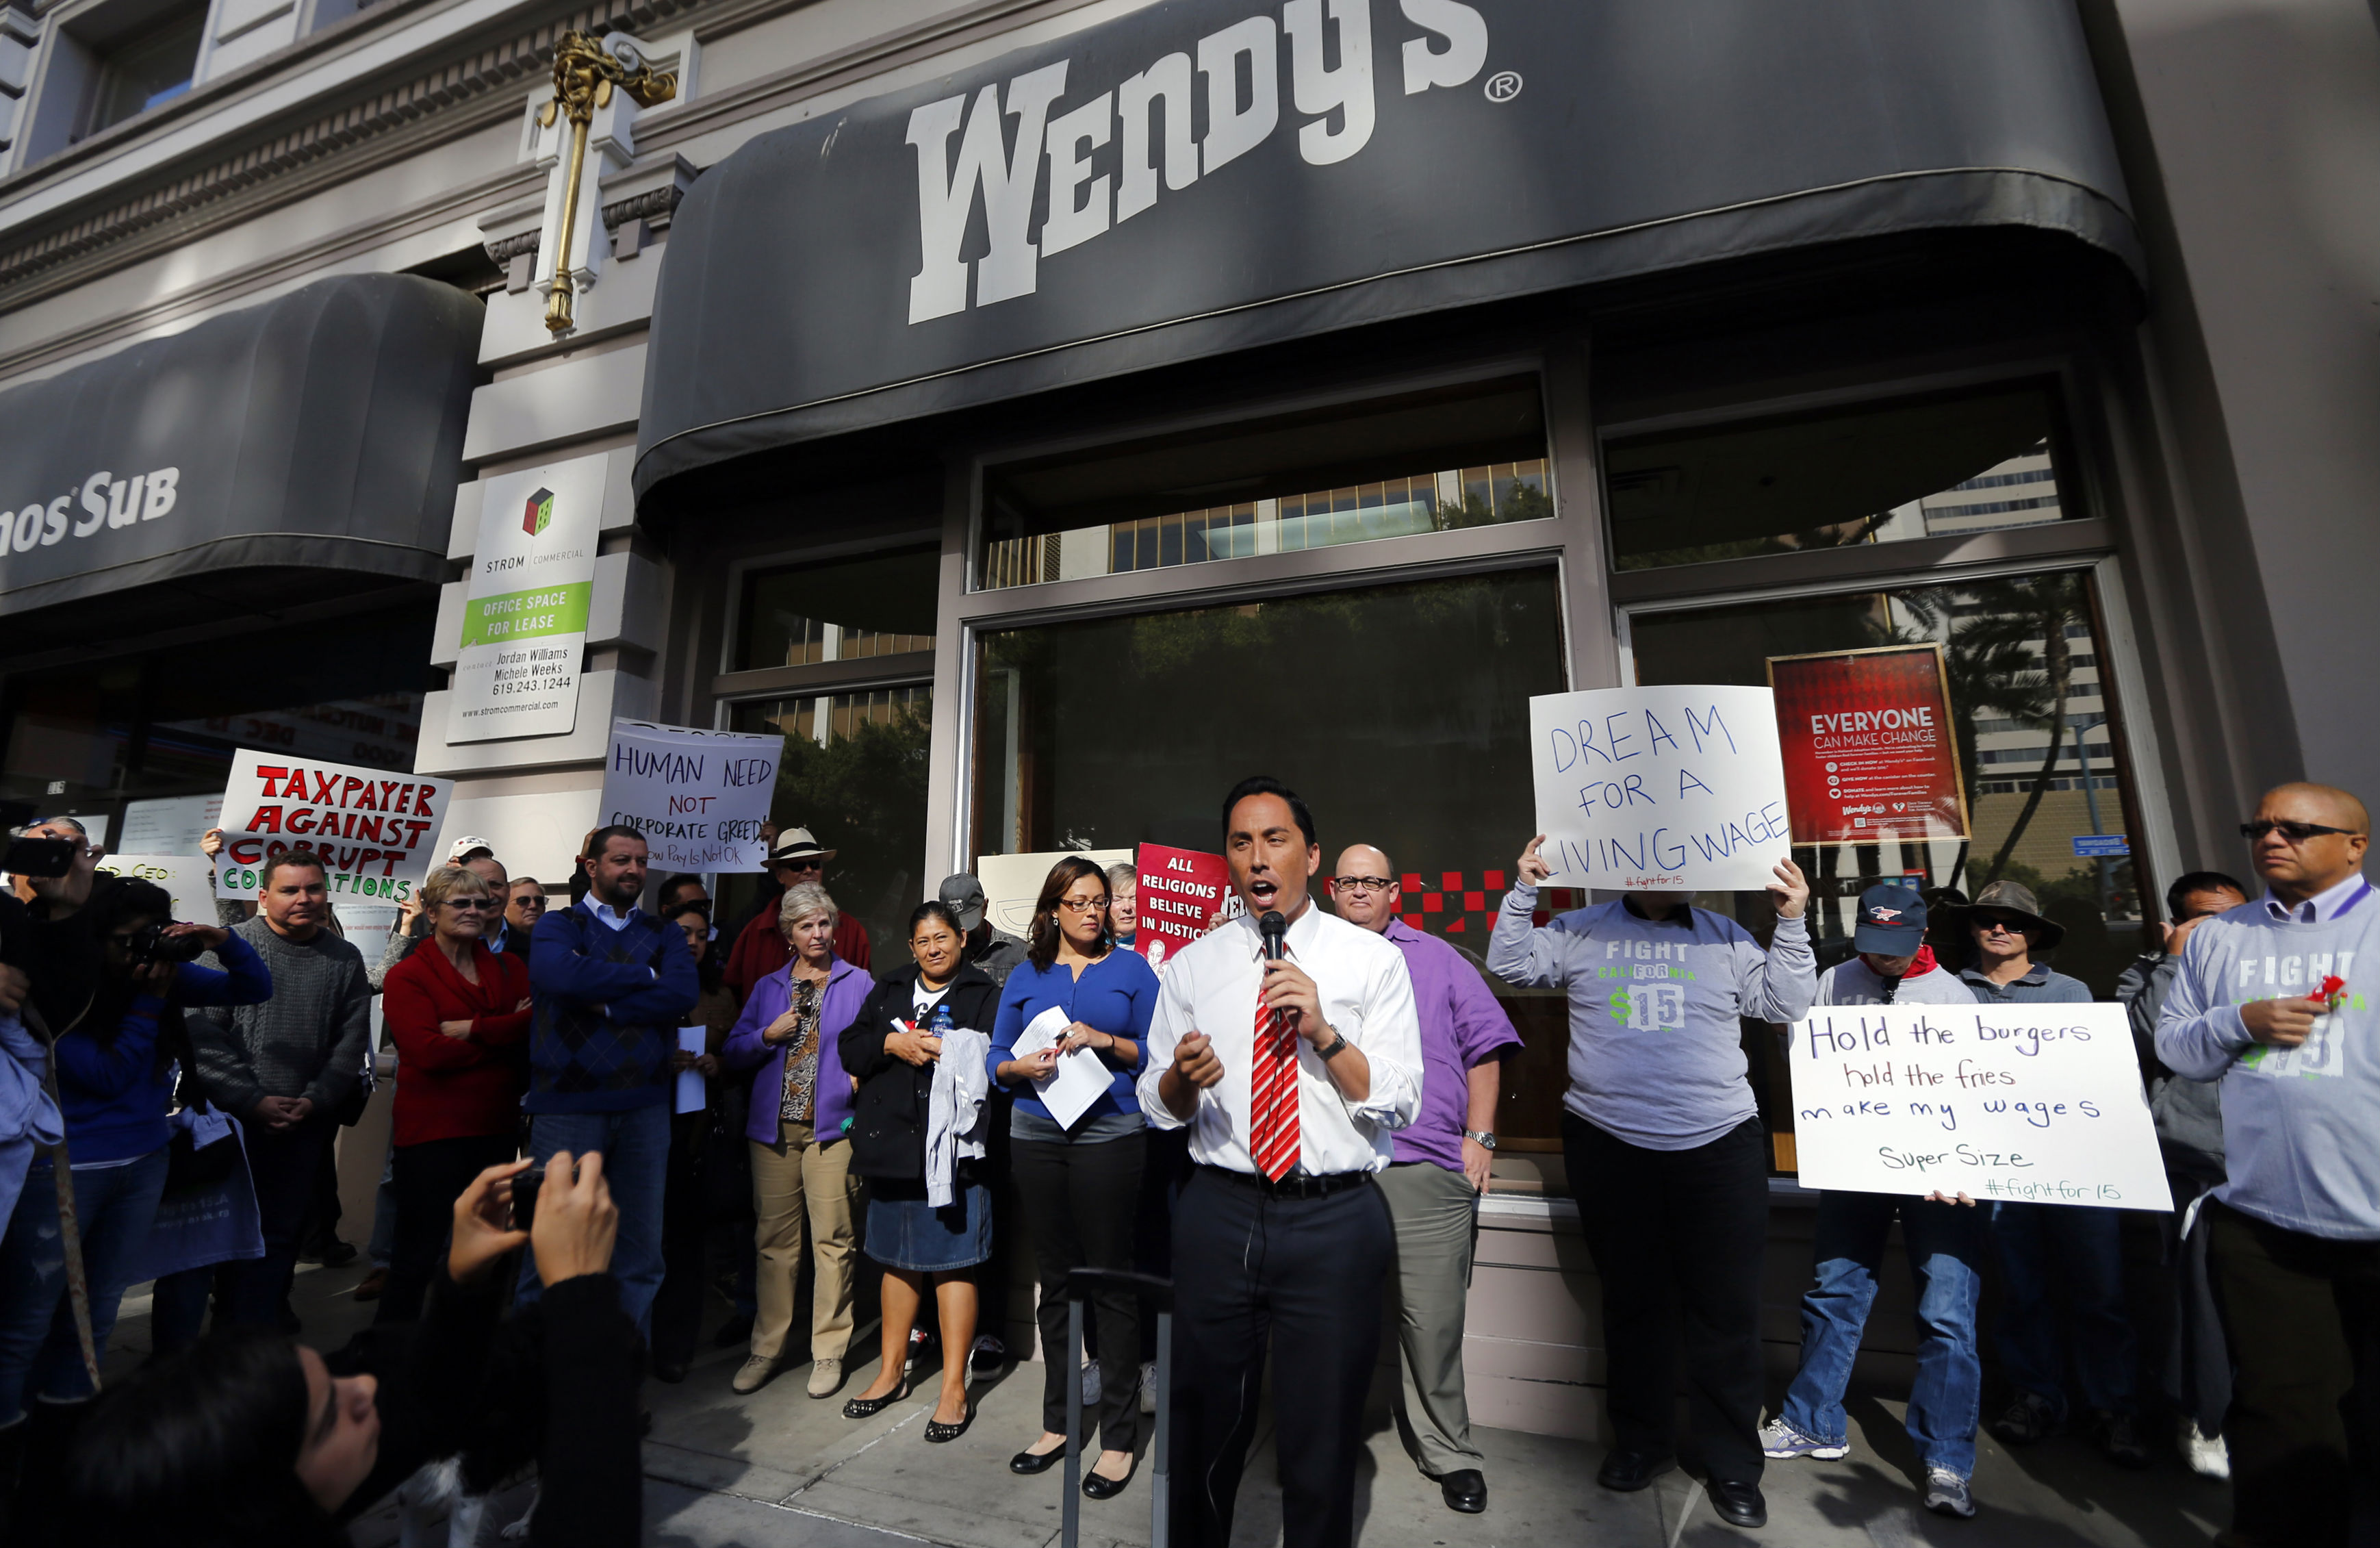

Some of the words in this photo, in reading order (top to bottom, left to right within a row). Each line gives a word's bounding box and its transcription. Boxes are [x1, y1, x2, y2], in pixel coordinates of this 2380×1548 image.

[73, 467, 179, 537] SUB
[486, 556, 524, 573] STROM
[533, 549, 584, 564] COMMERCIAL
[483, 598, 522, 616] OFFICE
[526, 592, 567, 609] SPACE
[487, 621, 509, 636] FOR
[515, 615, 554, 632] LEASE
[463, 661, 492, 671] contact
[496, 652, 526, 665] Jordan
[530, 648, 568, 661] Williams
[494, 666, 528, 682] Michele
[531, 663, 563, 676] Weeks
[493, 676, 570, 695] 619.243.1244
[462, 700, 558, 718] www.stromcommercial.com
[1810, 706, 1934, 735] EVERYONE
[1550, 705, 1737, 773] DREAM
[1814, 735, 1841, 749] CAN
[1843, 733, 1879, 747] MAKE
[1881, 728, 1936, 744] CHANGE
[615, 743, 704, 785] HUMAN
[724, 759, 771, 787] NEED
[257, 765, 436, 817] TAXPAYER
[1578, 774, 1656, 817] FOR
[1680, 769, 1714, 799] A
[669, 794, 717, 816] NOT
[1843, 804, 1871, 815] Wendy's
[245, 805, 432, 849] AGAINST
[611, 811, 709, 839] CORPORATE
[1691, 800, 1789, 862] WAGE
[648, 850, 663, 861] ow
[668, 844, 686, 867] Pay
[690, 848, 699, 865] Is
[702, 843, 722, 865] Not
[1167, 857, 1194, 873] ALL
[1142, 874, 1217, 899] RELIGIONS
[1149, 896, 1203, 919] BELIEVE
[1142, 916, 1155, 930] IN
[1160, 920, 1205, 941] JUSTIC
[1607, 939, 1688, 962] FIGHT
[1598, 963, 1697, 981] CALIFORNIA
[2239, 952, 2355, 987] FIGHT
[1609, 986, 1678, 1026] $15
[1808, 1015, 1891, 1059] Hold
[1909, 1015, 1956, 1045] the
[1975, 1015, 2092, 1056] burgers
[1843, 1061, 1894, 1089] hold
[1905, 1063, 1945, 1087] the
[1955, 1058, 2016, 1090] fries
[1910, 1100, 1956, 1131] my
[1983, 1097, 2101, 1128] wages
